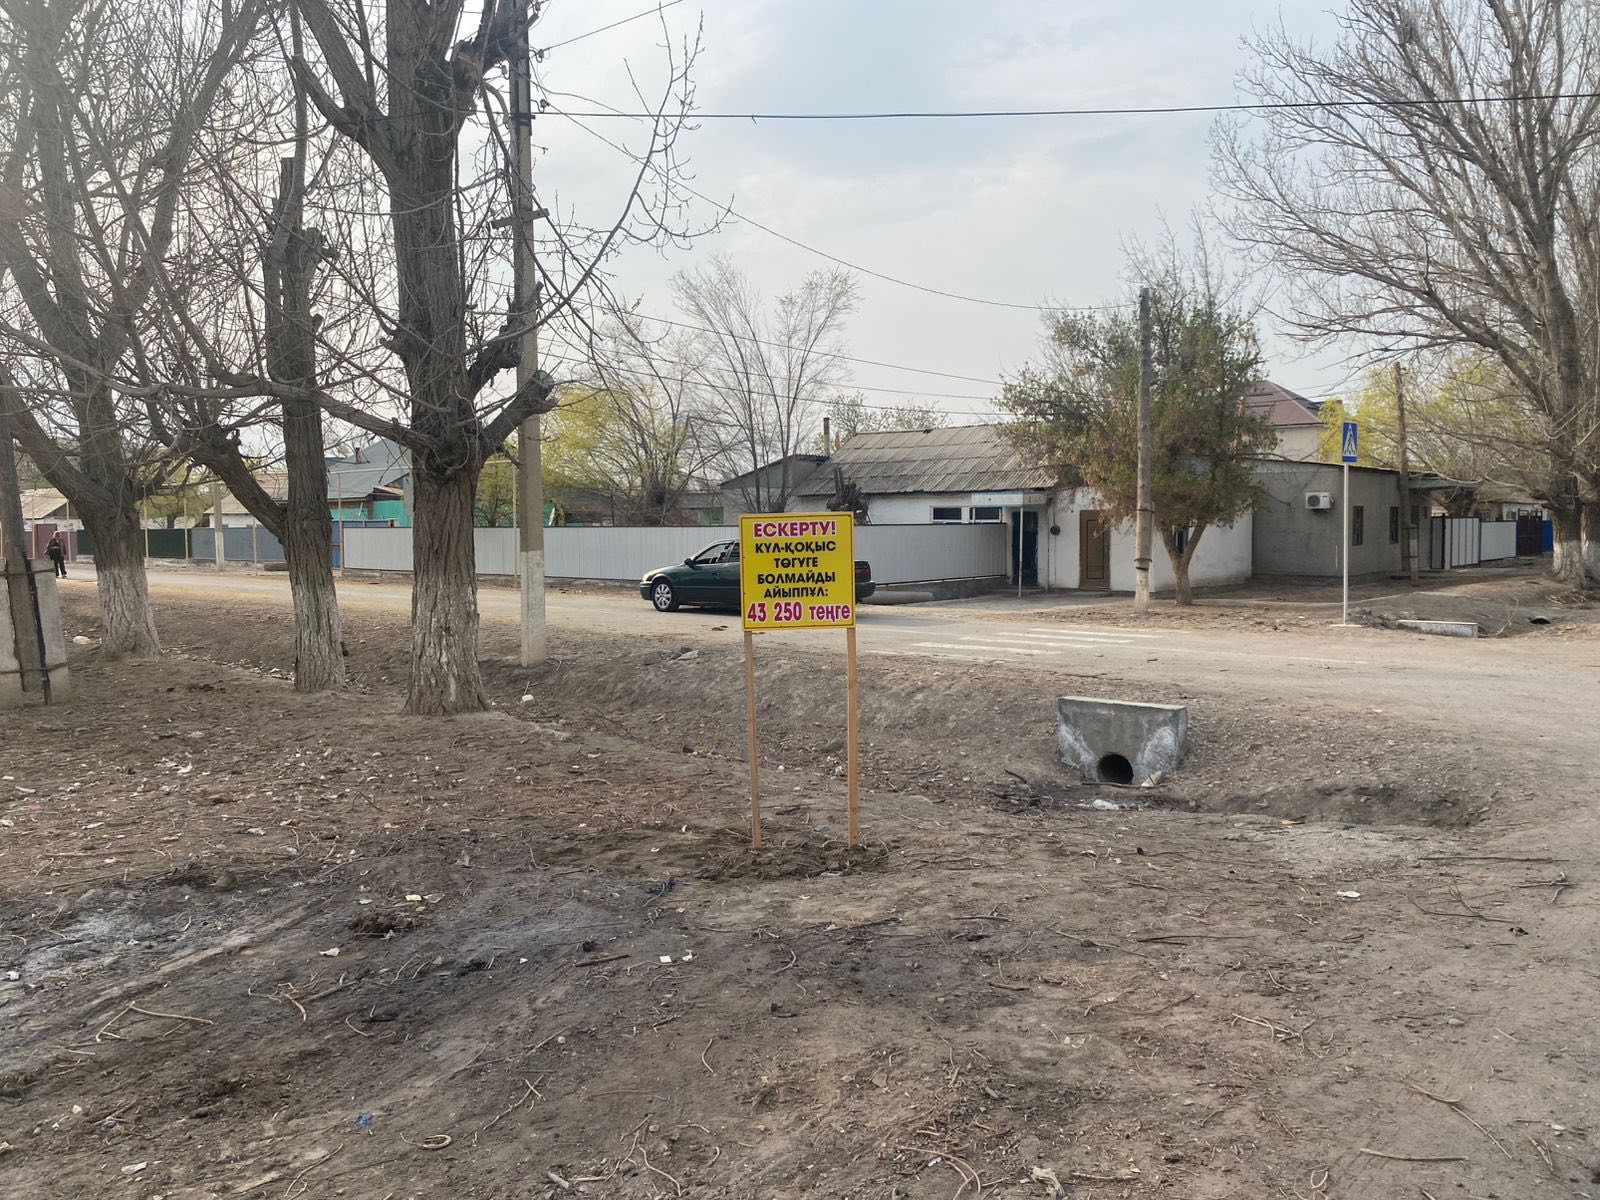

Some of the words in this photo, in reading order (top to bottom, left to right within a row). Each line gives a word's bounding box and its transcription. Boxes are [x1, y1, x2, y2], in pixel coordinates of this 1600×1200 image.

[754, 521, 836, 537] ЕСКЕРТУ!
[755, 541, 836, 554] КҮЛ-ҚОҚЫС
[774, 557, 818, 568] ТӨГУГЕ
[757, 570, 836, 584] БОЛМАЙДЫ
[764, 586, 828, 599] АЙЫППҰЛ:
[747, 602, 767, 622] 43
[774, 601, 802, 621] 250
[809, 604, 850, 622] теңге
